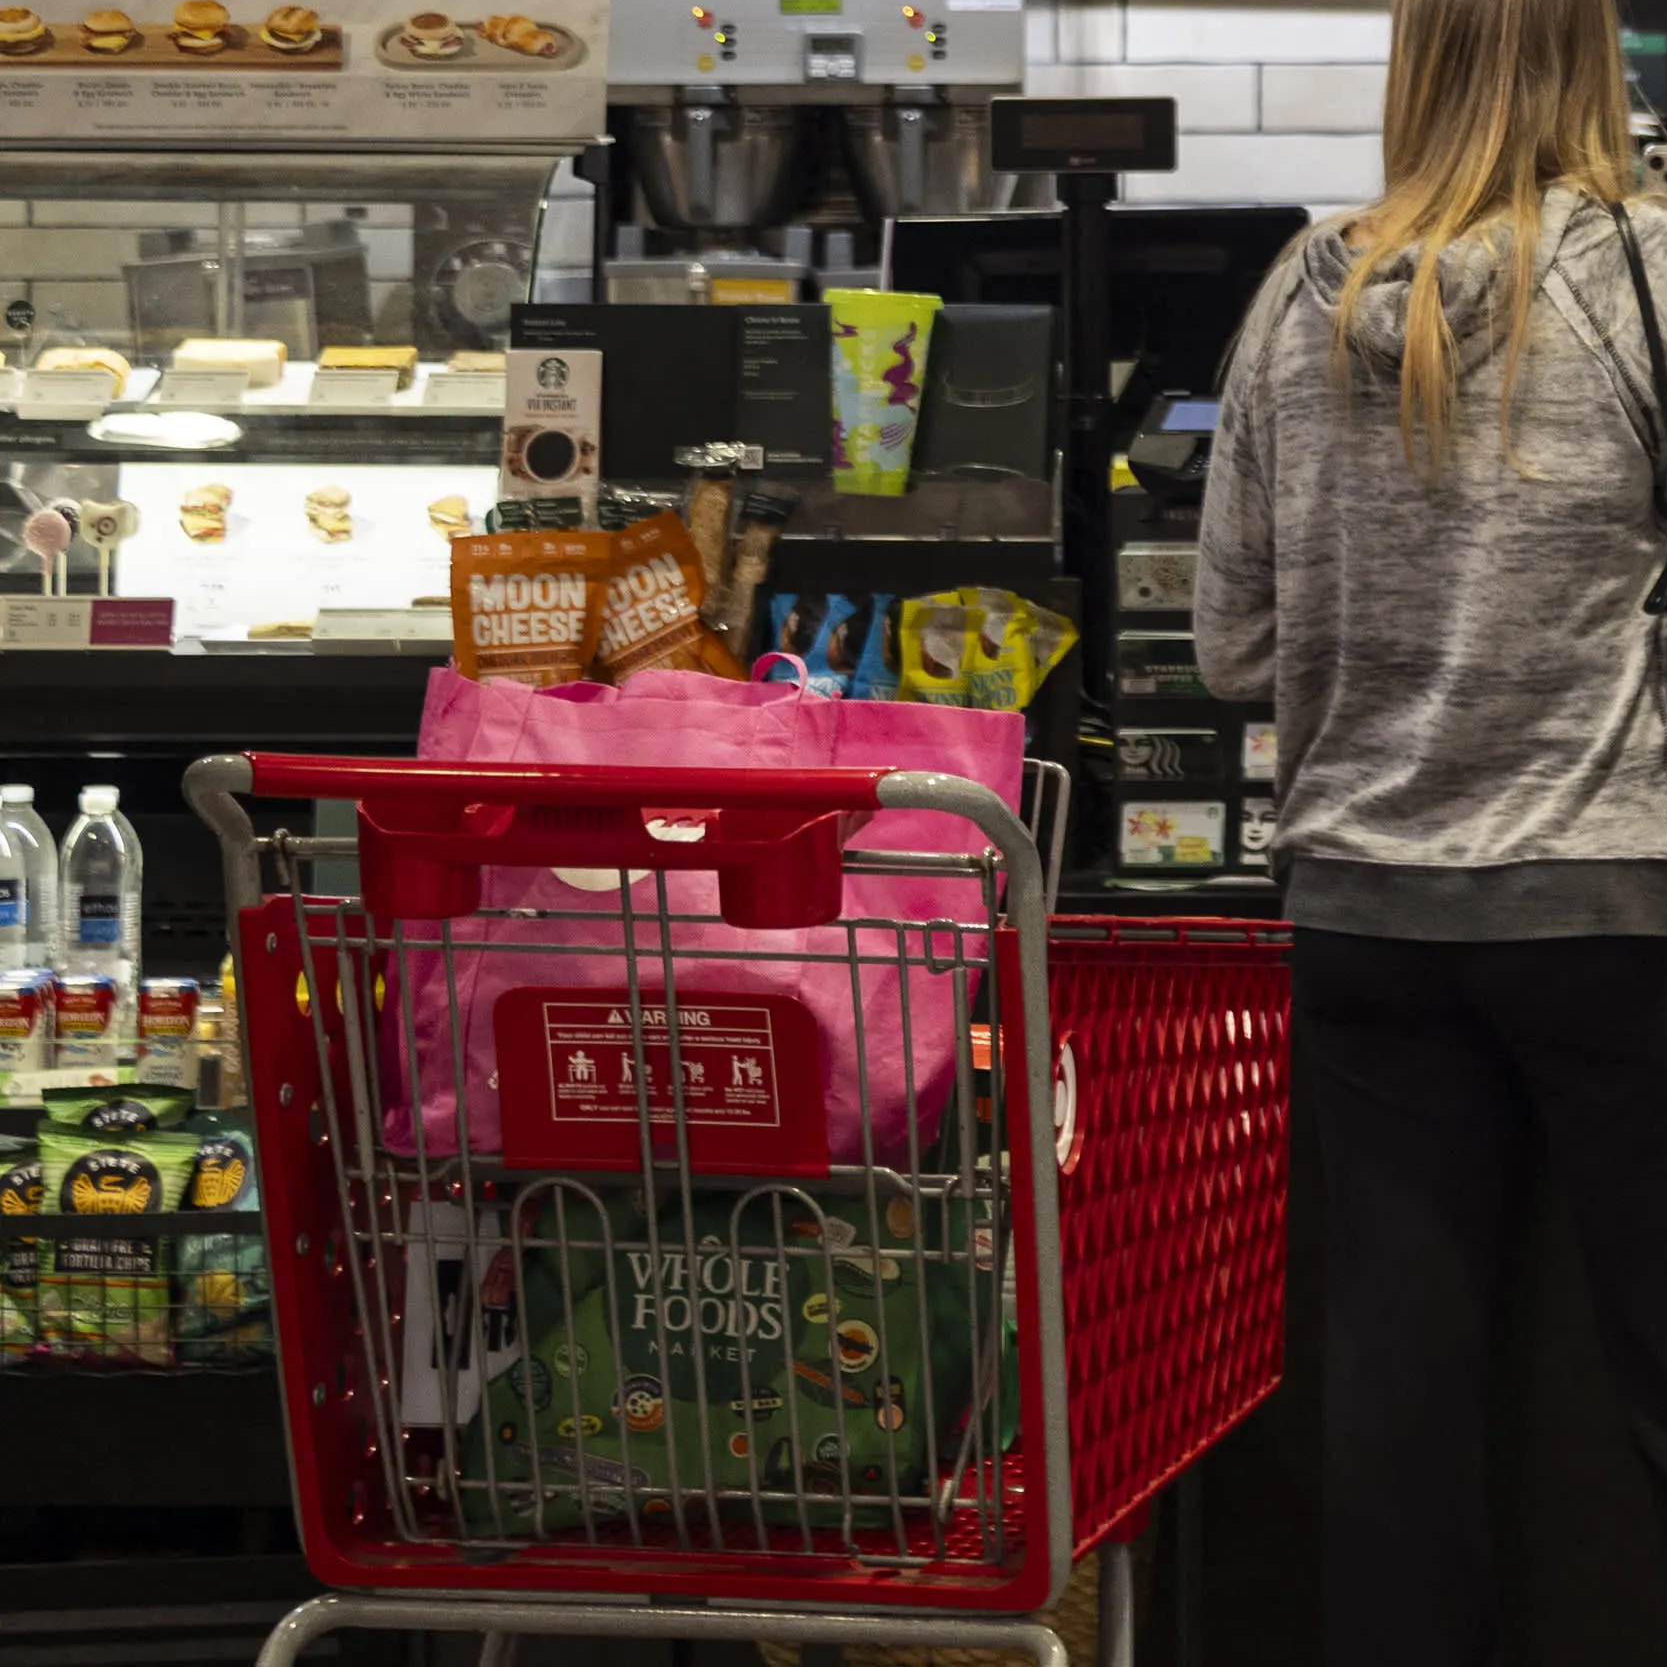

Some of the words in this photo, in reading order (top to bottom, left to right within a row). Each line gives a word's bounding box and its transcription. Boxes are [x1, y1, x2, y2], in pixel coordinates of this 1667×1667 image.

[470, 573, 586, 613] MOON
[472, 611, 584, 646] CHEESE
[625, 1010, 711, 1026] ARING
[88, 1156, 141, 1174] SIETE
[631, 1294, 783, 1340] FOODS
